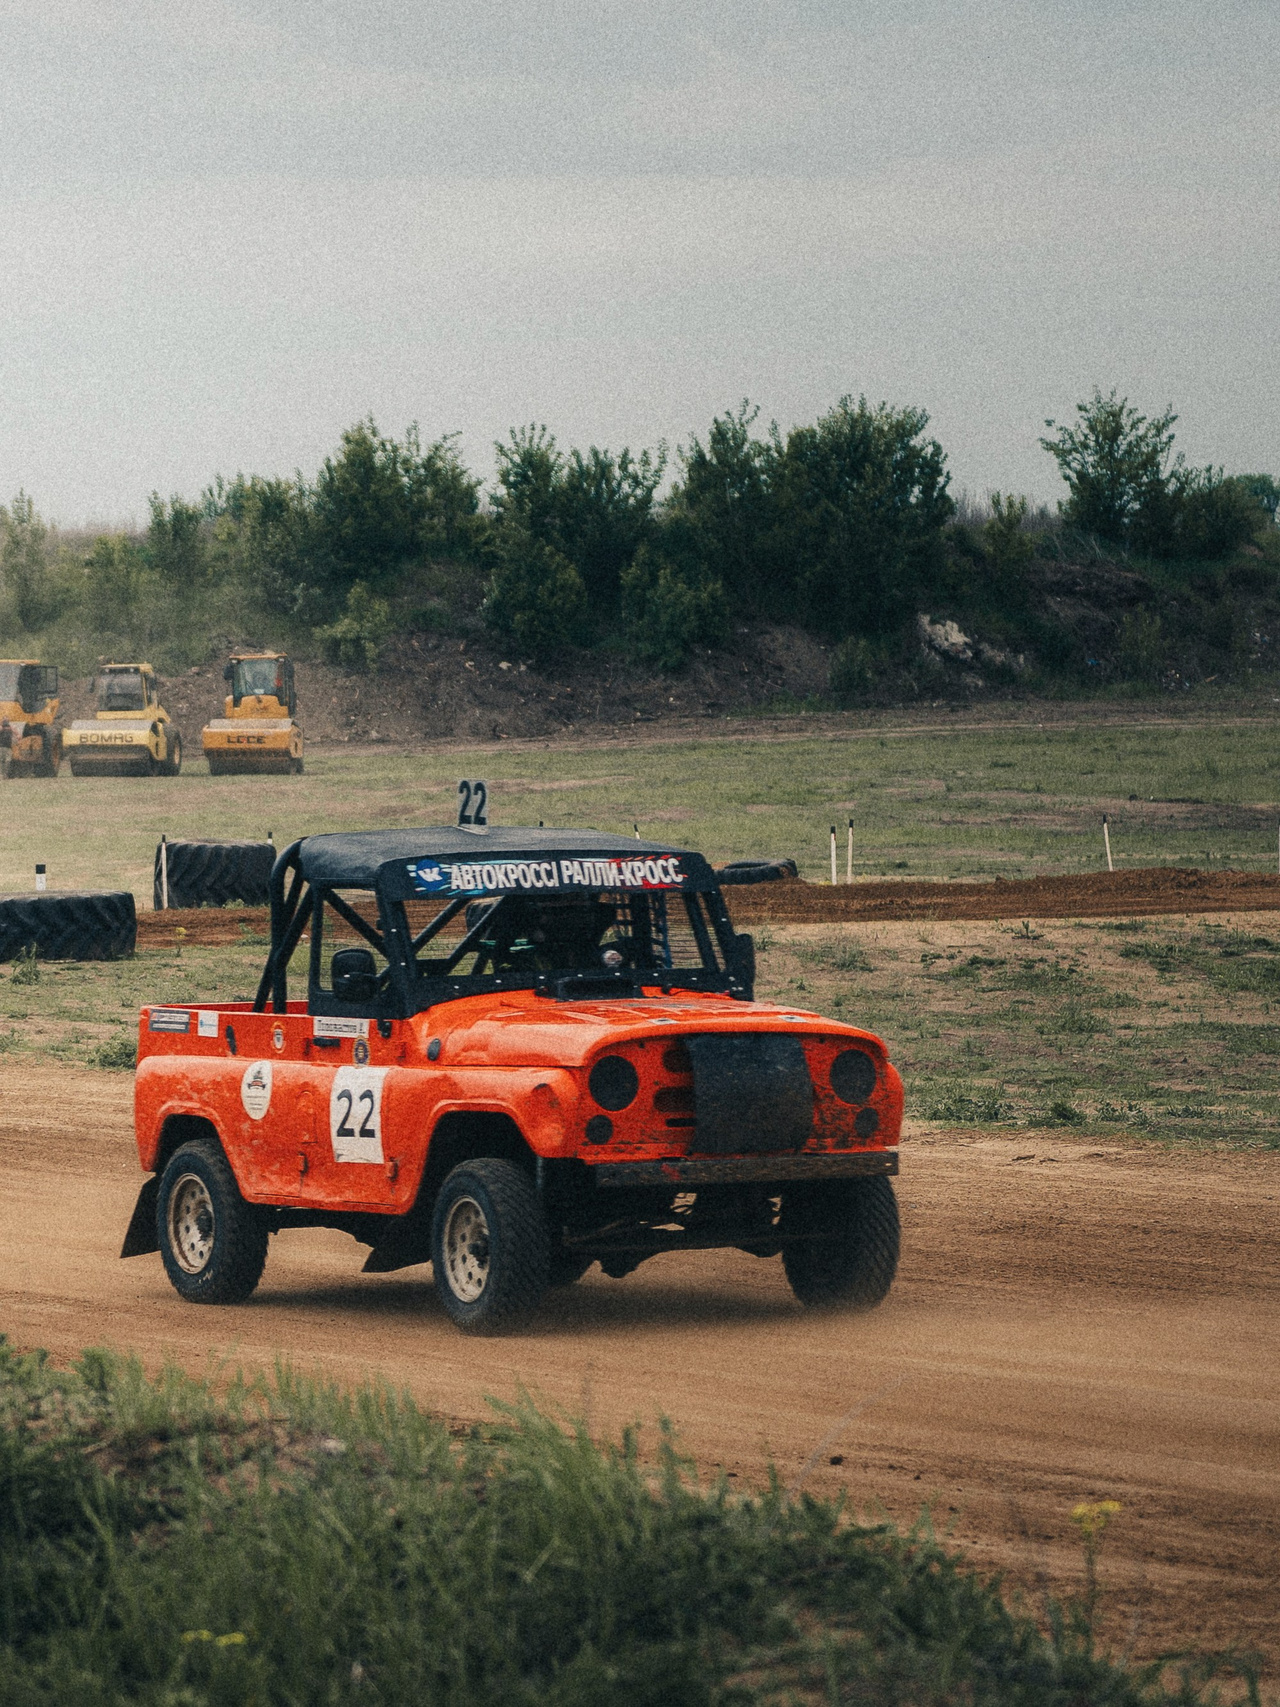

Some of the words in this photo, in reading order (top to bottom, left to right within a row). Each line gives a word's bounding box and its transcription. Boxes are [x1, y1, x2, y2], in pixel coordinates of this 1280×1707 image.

[79, 733, 134, 743] BOMAG
[458, 780, 487, 826] 22
[336, 1088, 376, 1138] 22
